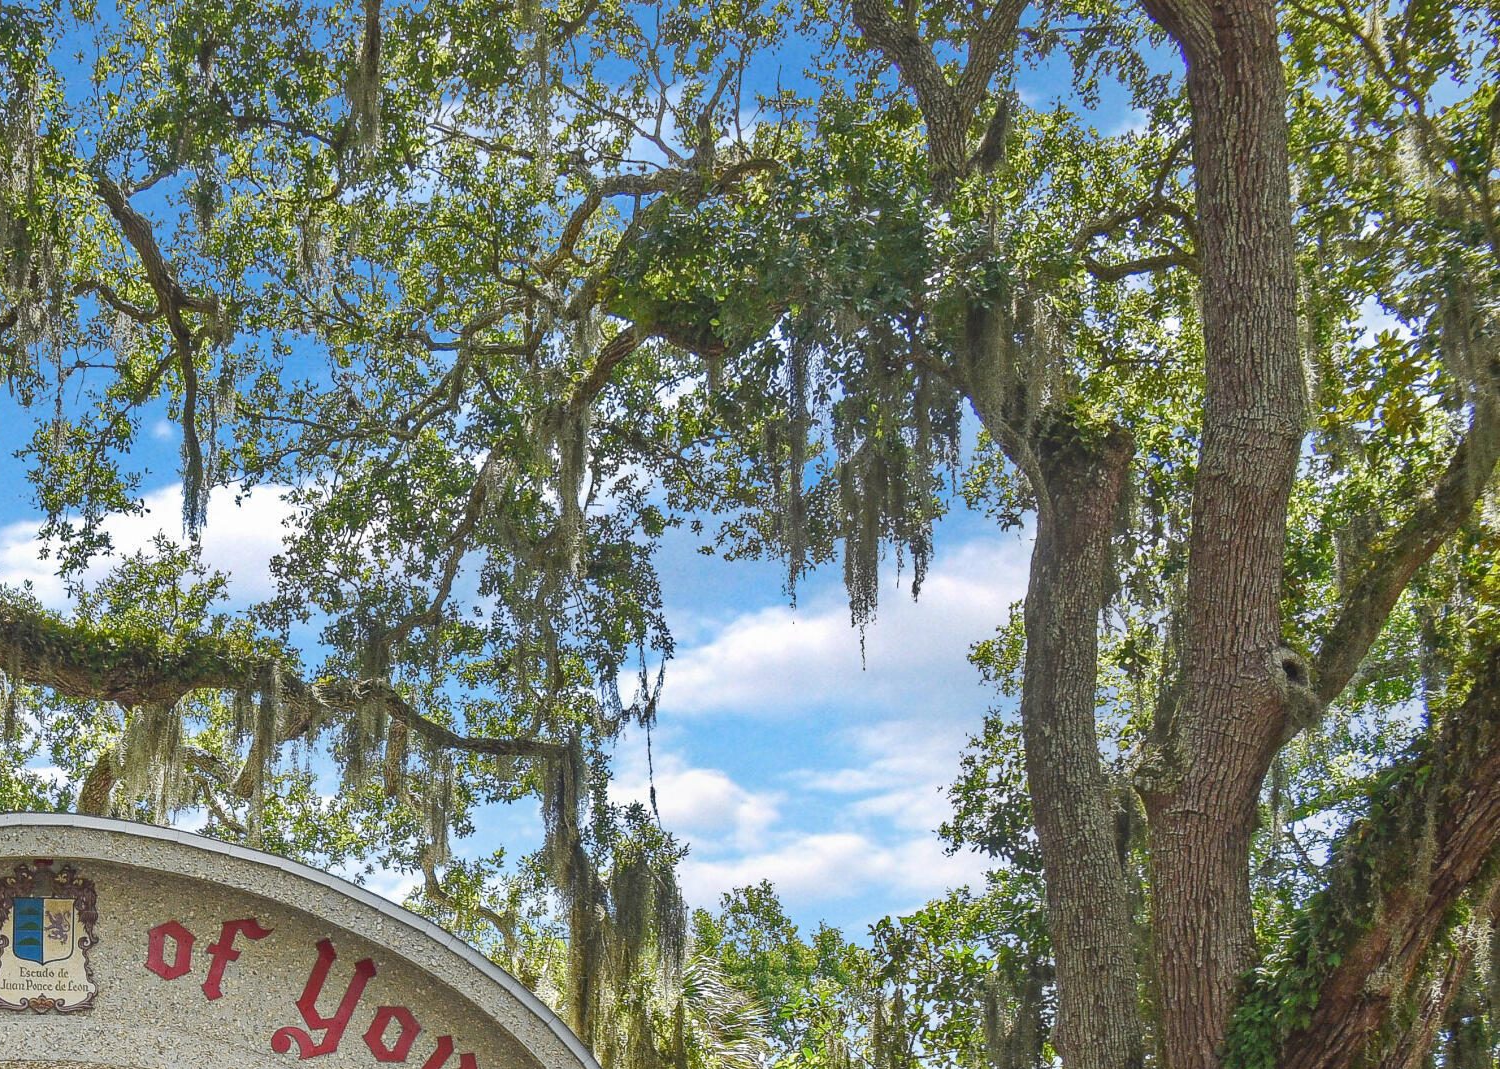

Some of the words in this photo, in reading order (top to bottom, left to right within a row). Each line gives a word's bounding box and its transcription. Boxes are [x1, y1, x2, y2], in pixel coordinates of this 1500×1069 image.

[145, 918, 274, 1001] of
[19, 967, 55, 978] Escudo
[58, 967, 69, 978] de
[0, 979, 25, 991] Juan
[26, 979, 54, 992] Ponce
[55, 980, 66, 991] de
